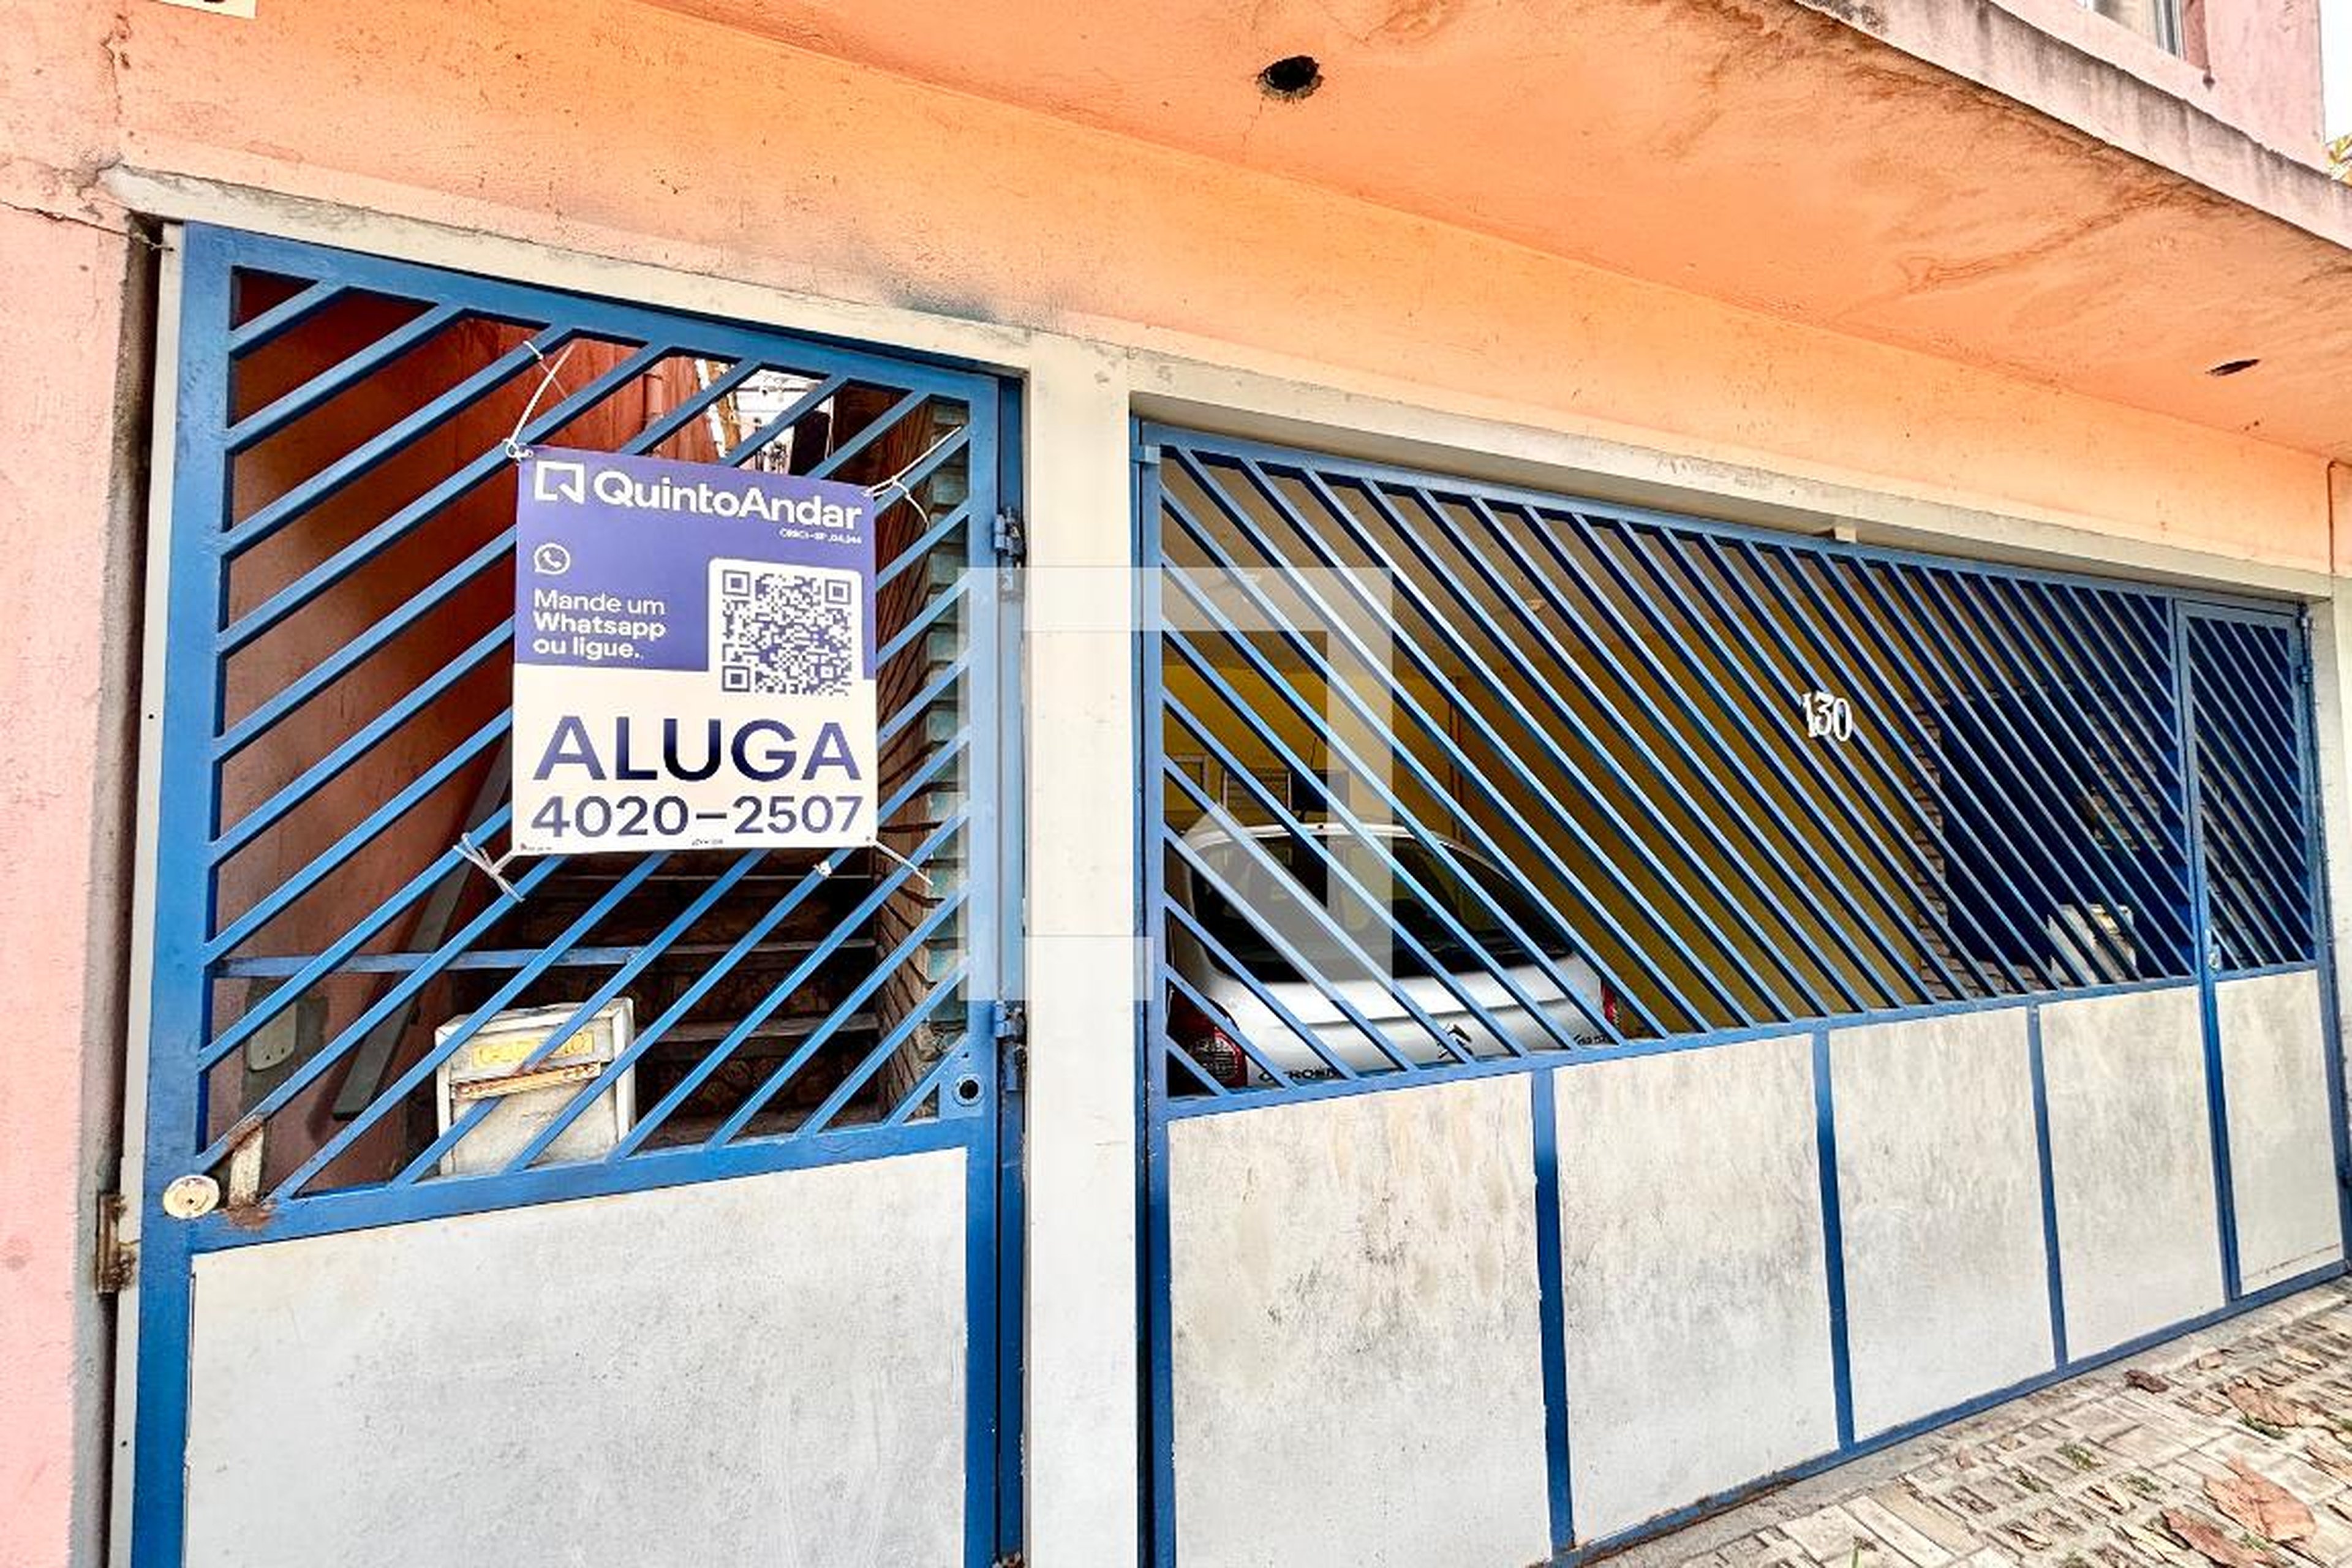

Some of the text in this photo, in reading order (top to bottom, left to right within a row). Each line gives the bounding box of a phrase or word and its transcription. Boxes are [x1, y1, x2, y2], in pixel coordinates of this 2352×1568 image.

[594, 470, 862, 530] QuintoAndar
[534, 589, 665, 616] Mande um
[533, 613, 666, 640] Whatsapp
[533, 639, 641, 660] ou ligue.
[1802, 692, 1852, 741] 130
[532, 715, 862, 782] ALUGA
[530, 796, 864, 838] 4020-2507
